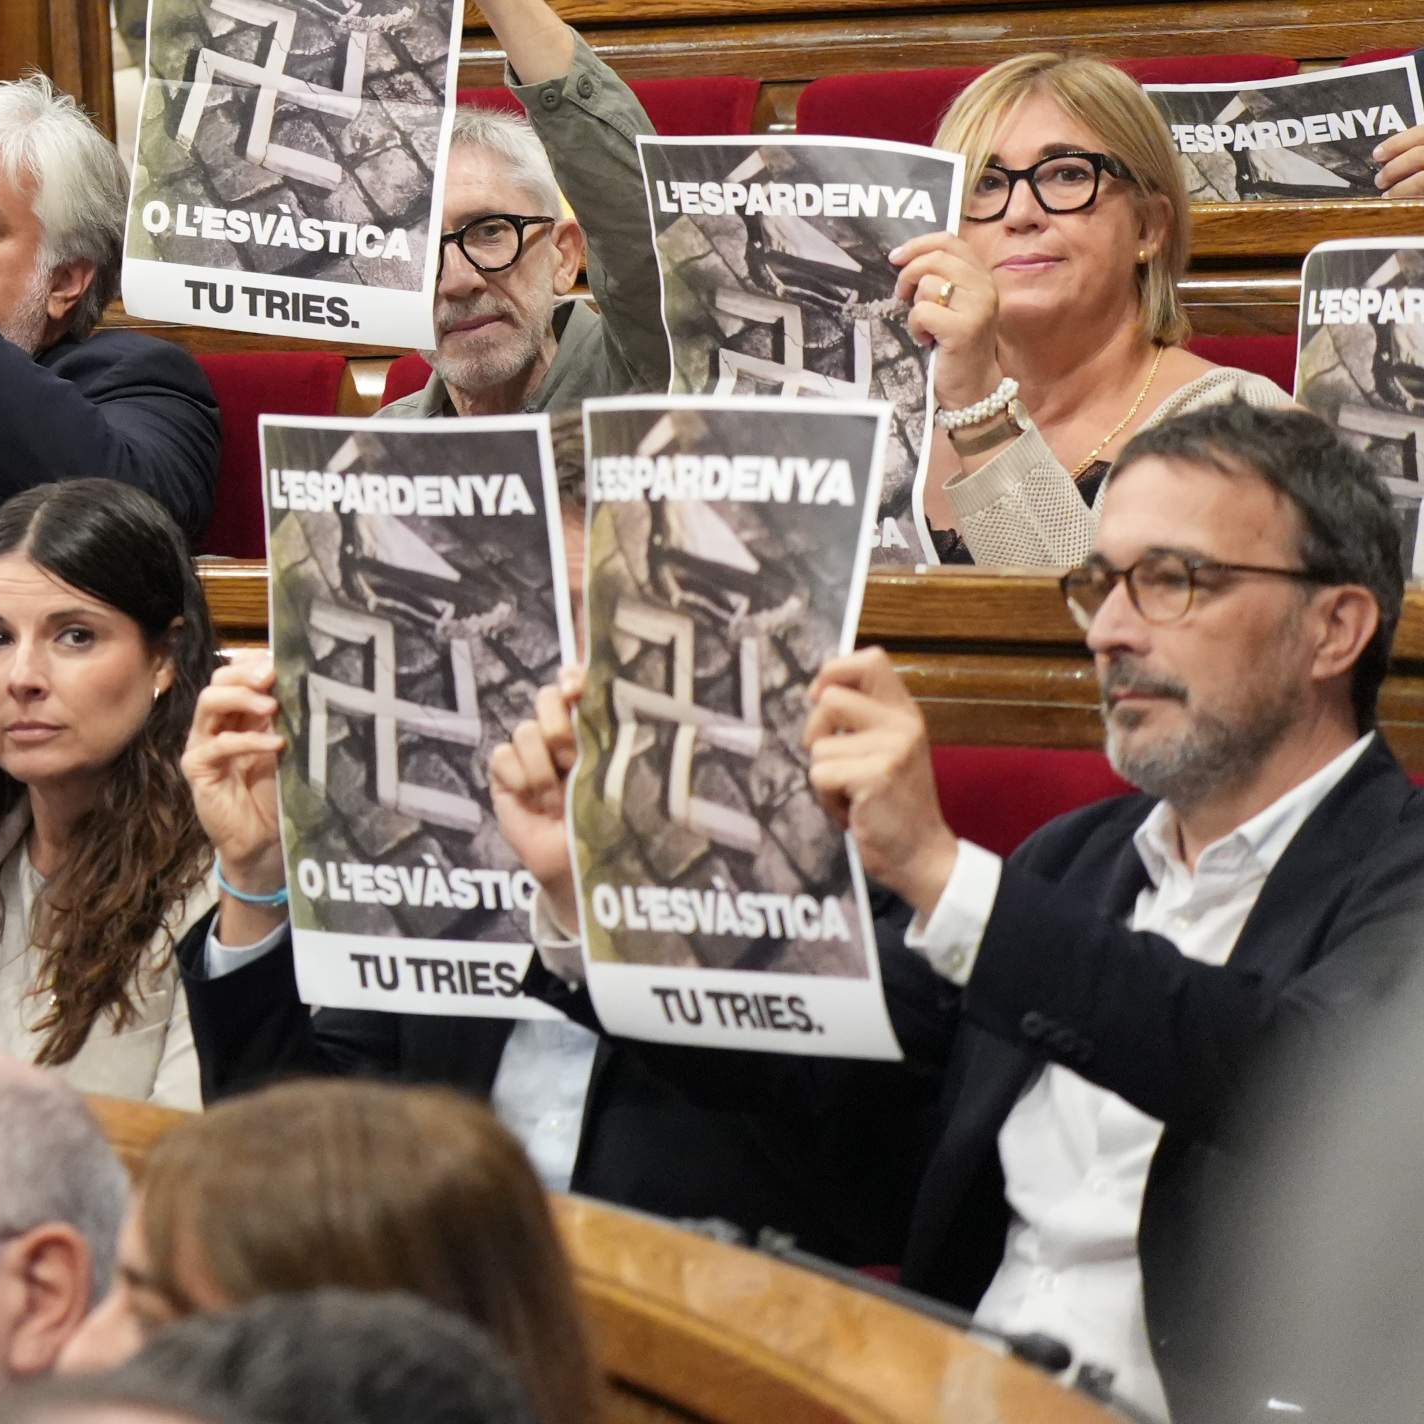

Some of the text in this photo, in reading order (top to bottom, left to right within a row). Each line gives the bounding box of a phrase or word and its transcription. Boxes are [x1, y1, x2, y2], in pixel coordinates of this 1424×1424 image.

[655, 180, 937, 222] L'ESPARDENYA
[142, 201, 412, 261] O L'ESVÀSTICA
[184, 279, 360, 329] TU TRIES.
[270, 468, 536, 517] L'ESPARDENYA
[298, 853, 534, 911] O L'ESVÀSTIC
[593, 879, 851, 942] O L'ESVÀSTICA
[350, 952, 399, 992] TU
[653, 987, 823, 1034] TU TRIES.
